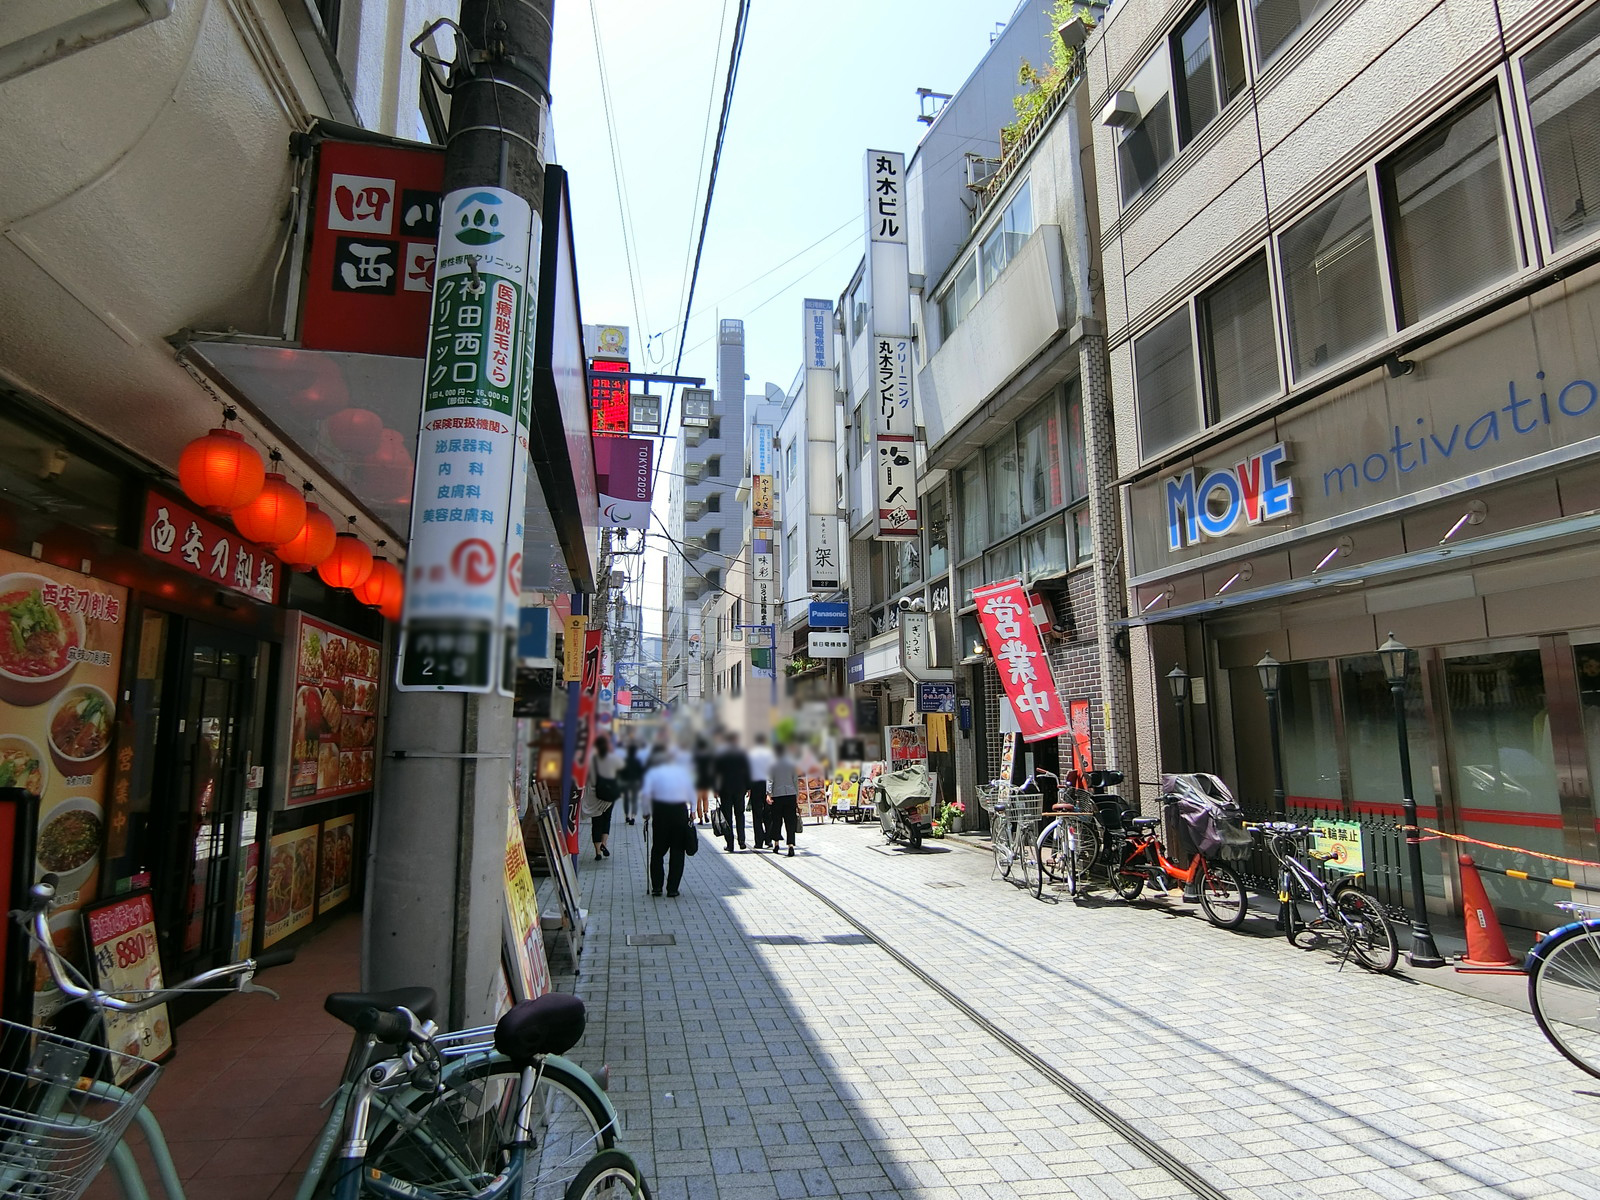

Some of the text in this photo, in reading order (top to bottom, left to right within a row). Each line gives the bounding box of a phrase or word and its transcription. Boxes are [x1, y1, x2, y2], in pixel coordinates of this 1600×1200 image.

[876, 156, 899, 237] 丸木ビル
[431, 280, 456, 387] クリニック
[452, 277, 486, 383] 神田西口
[493, 283, 513, 383] 医療脱毛なら
[879, 341, 894, 430] 丸木ランドリー
[897, 342, 909, 408] クリーニング
[435, 439, 493, 455] 泌尿器科
[1323, 371, 1597, 497] motivatio
[437, 485, 480, 499] 皮膚科
[637, 446, 648, 499] TOKYO 2020
[1165, 442, 1294, 552] MOVE
[423, 508, 494, 524] 美容皮膚科
[815, 547, 834, 568] 架
[42, 584, 119, 622] 西安刀削麺
[811, 609, 847, 619] Panasonic
[983, 595, 1051, 727] 営業中
